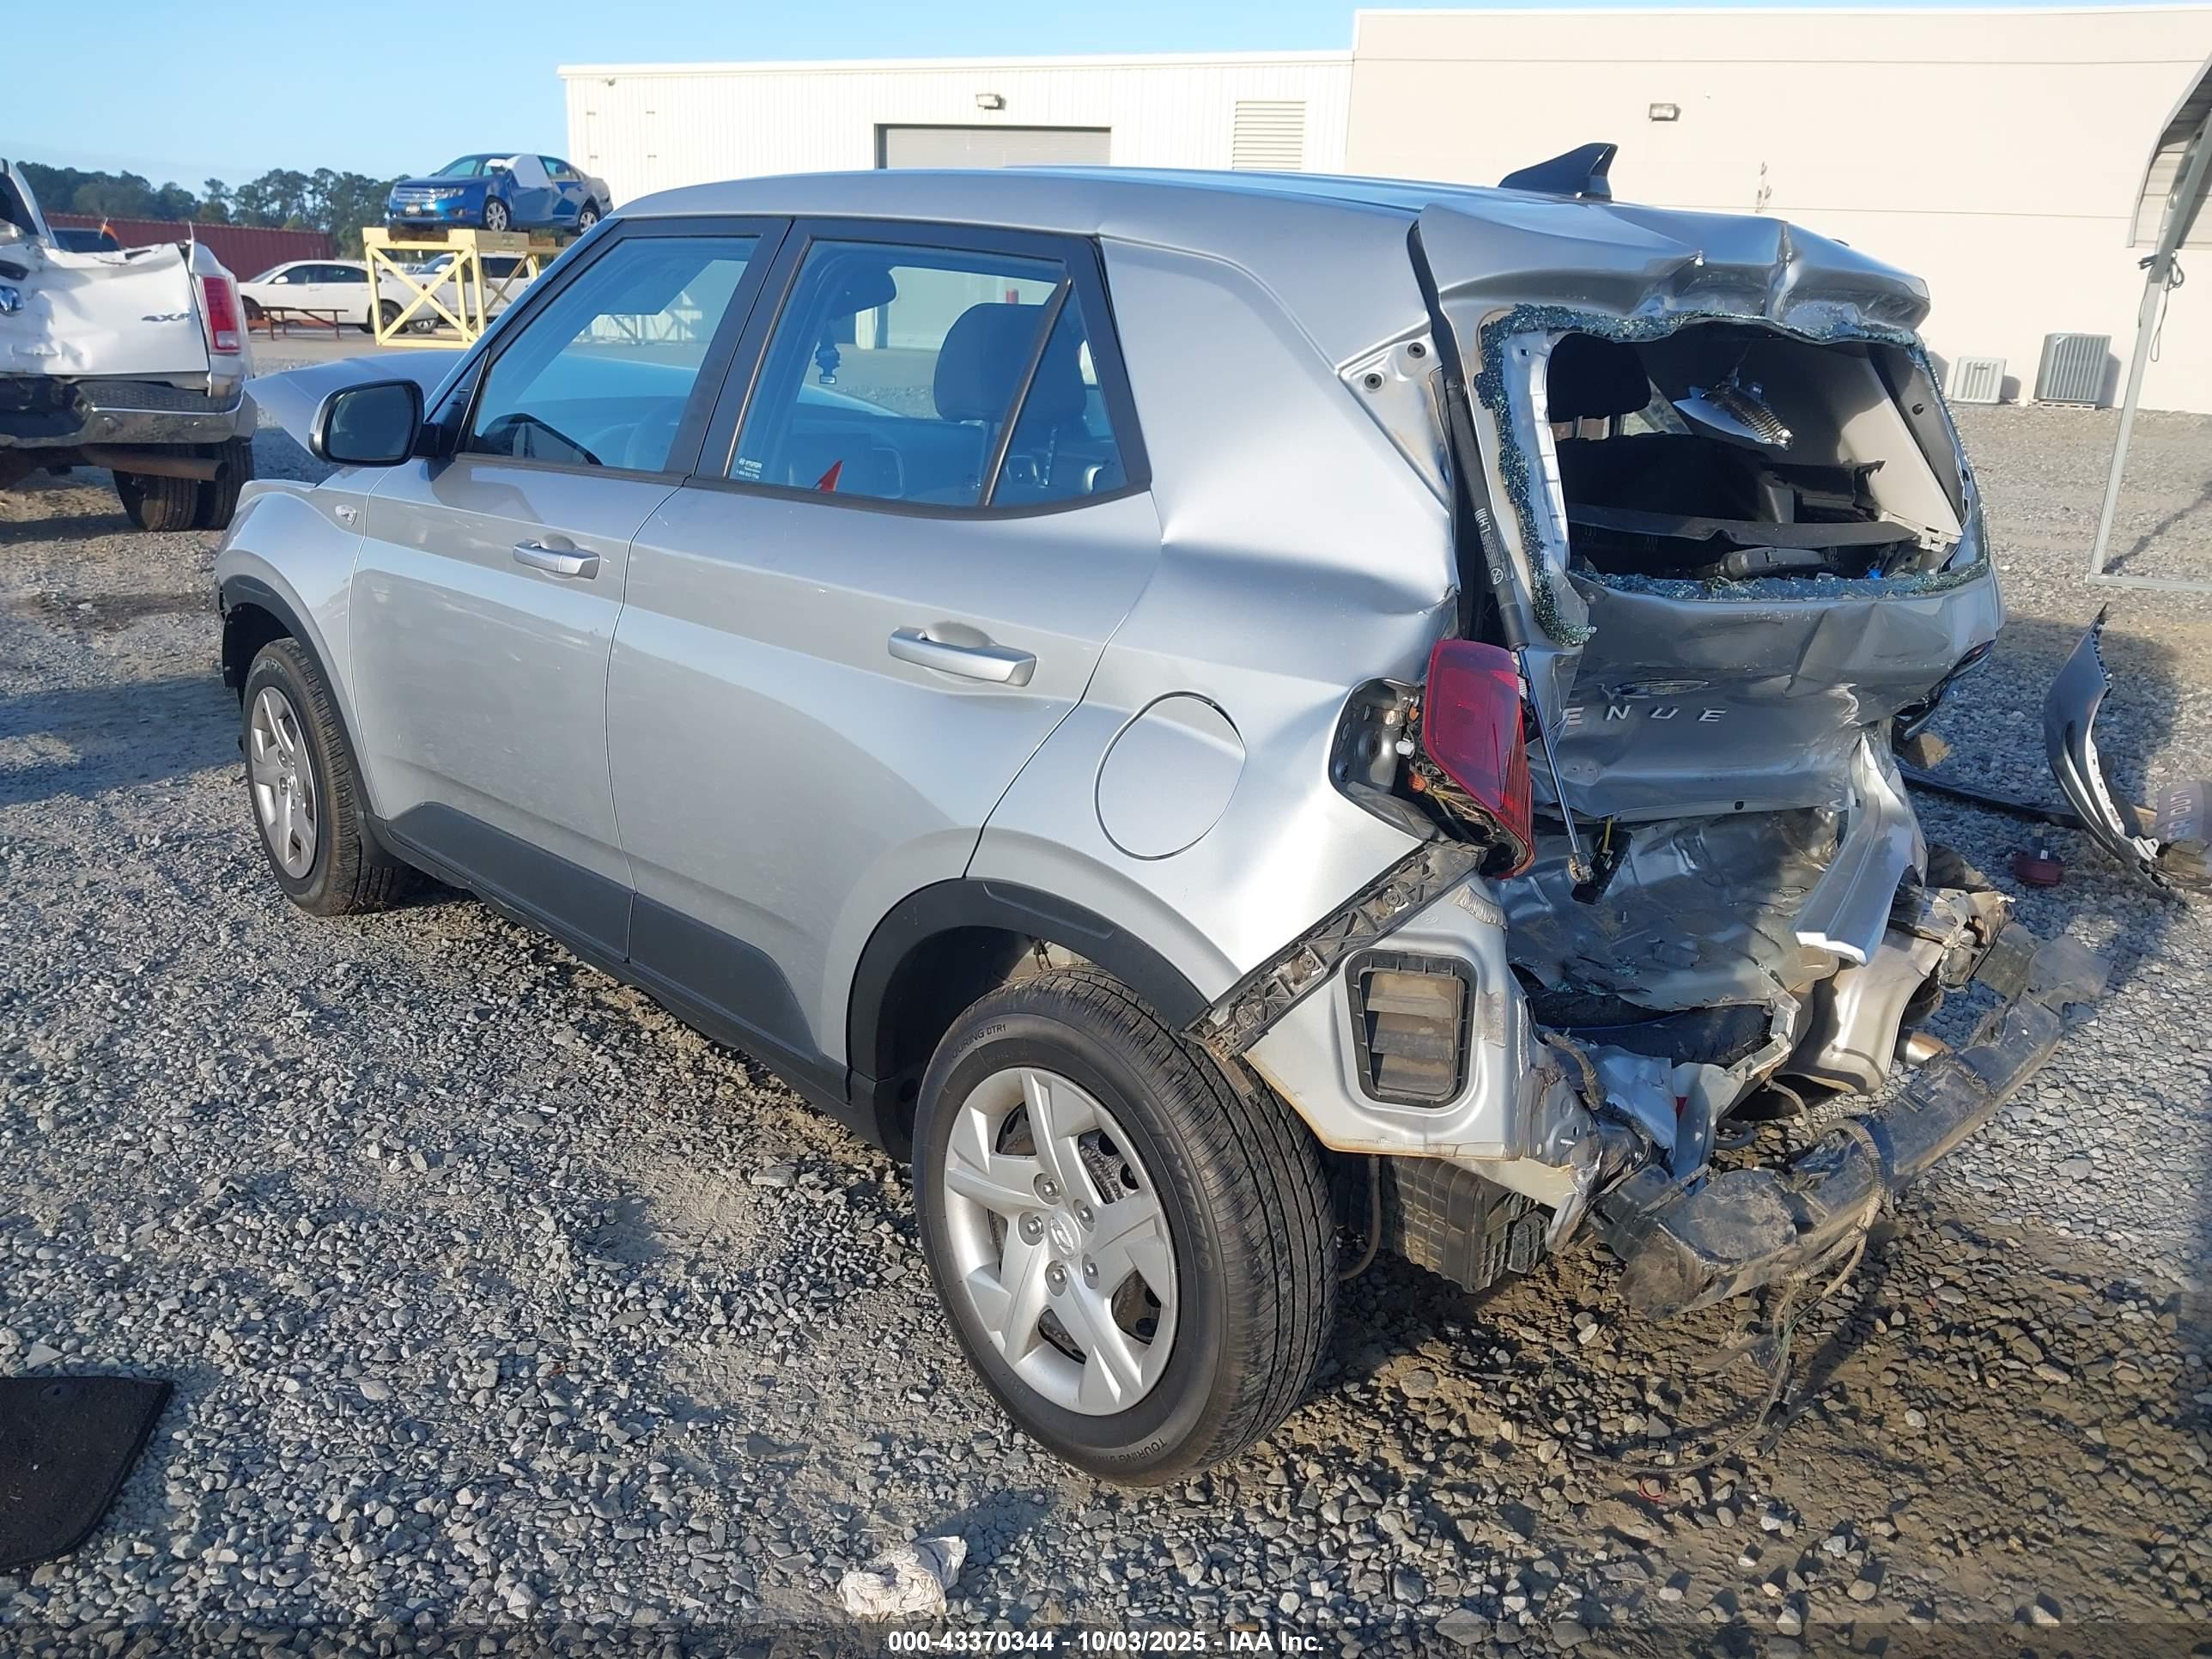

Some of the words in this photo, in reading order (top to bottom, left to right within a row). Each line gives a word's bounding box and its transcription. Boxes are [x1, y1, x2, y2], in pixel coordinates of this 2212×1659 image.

[950, 1029, 985, 1060] OURING
[987, 1024, 1006, 1036] DTR1
[1119, 1437, 1168, 1462] TOURING
